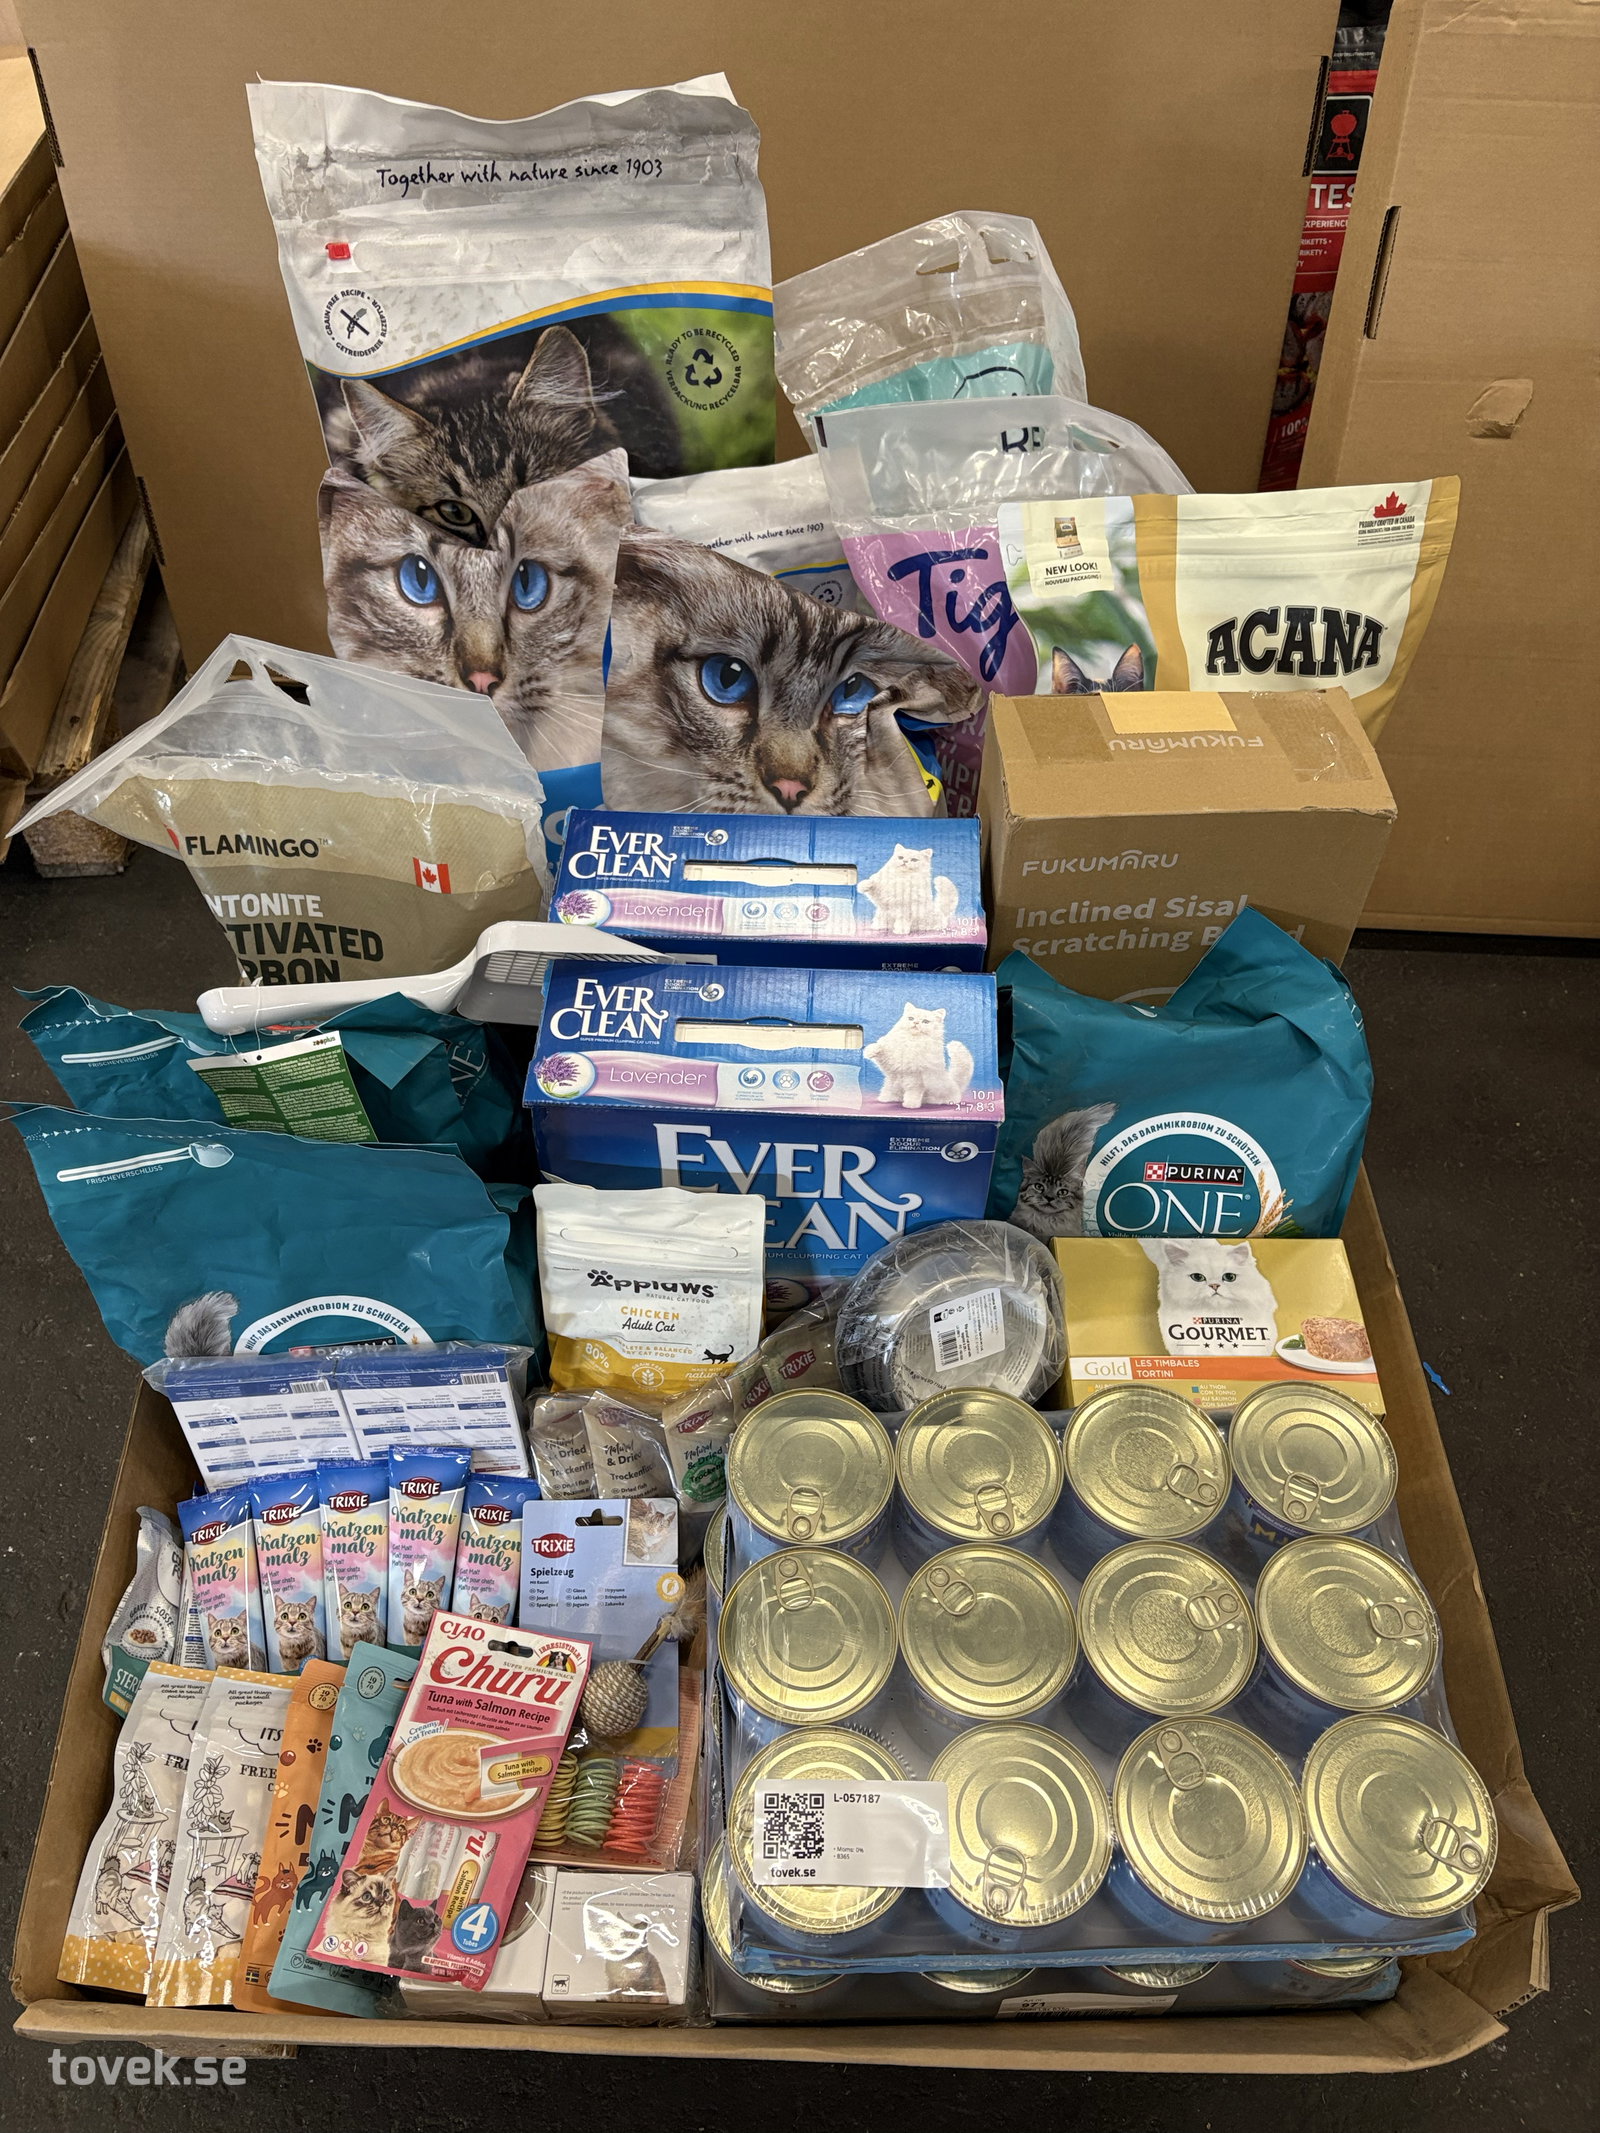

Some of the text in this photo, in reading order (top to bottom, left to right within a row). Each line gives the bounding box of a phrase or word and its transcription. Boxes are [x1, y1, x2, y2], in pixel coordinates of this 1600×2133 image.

[376, 159, 663, 198] Together with nature since 1903
[324, 289, 365, 336] GRAIN FREE RECIPE
[336, 299, 387, 357] GETREIDEFREIE REZEPTUR
[666, 328, 740, 365] READY TO BE RECYCLED
[666, 366, 741, 411] VERPACKUNG RECYCELBAR
[735, 522, 824, 545] with nature since 1903
[1045, 562, 1098, 576] NEW LOOK!
[1045, 574, 1099, 586] NOUVEAU PACKAGING
[1206, 605, 1383, 678] ACANA
[185, 835, 320, 858] FLAMINGO
[590, 826, 677, 861] EVER
[568, 851, 674, 879] CLEAN
[624, 902, 714, 918] Lavender
[1015, 894, 1248, 929] Inclined Sisal
[1013, 927, 1192, 956] Scratching
[574, 978, 669, 1020] EVER
[550, 1008, 663, 1040] CLEAN
[312, 1036, 336, 1047] zooplus
[88, 1052, 159, 1068] FRISCHEVERSCHLUSS
[610, 1067, 707, 1086] Lavender
[976, 1102, 995, 1112] 8.3
[1100, 1120, 1262, 1167] HILFT, DAS DARMMIKROBIOM ZU SCHÜTZEN
[86, 1164, 163, 1185] FRISCHEVERSCHLUSS
[653, 1123, 923, 1214] EVER
[1167, 1166, 1239, 1181] PURINA
[1103, 1182, 1244, 1236] ONE
[587, 1268, 715, 1298] Applaws
[646, 1293, 675, 1301] NATURAL
[620, 1306, 680, 1320] CHICKEN
[1203, 1317, 1240, 1325] PURINA
[245, 1302, 411, 1351] HILFT, DAS DARMMIKROBIOM ZU SCHÜTZEN
[621, 1317, 676, 1333] Adult Cat
[1168, 1323, 1269, 1342] GOURMET
[585, 1342, 610, 1369] 80%
[653, 1346, 693, 1355] BALANCED
[1083, 1361, 1128, 1378] Gold
[1135, 1358, 1200, 1368] LES TIMBALES
[1136, 1369, 1174, 1378] TORTINI
[559, 1445, 586, 1459] Dried
[619, 1451, 642, 1465] Dried
[392, 1506, 457, 1526] Katzen-
[322, 1521, 388, 1540] Katzen-
[400, 1525, 447, 1545] malz
[257, 1531, 321, 1552] Katzen-
[331, 1539, 377, 1557] malz
[189, 1547, 248, 1572] Katzen-
[266, 1549, 311, 1567] malz
[468, 1552, 514, 1571] malz
[197, 1564, 240, 1586] malz
[530, 1567, 575, 1578] Spielzeug
[130, 1602, 174, 1627] GRAVY SOSSE
[440, 1620, 485, 1641] CIAO
[539, 1642, 582, 1662] IRRESISTIBLE!
[429, 1646, 572, 1706] Churu
[503, 1661, 575, 1680] SUPER PREMIUM SNACK
[428, 1690, 551, 1724] Tuna with Salmon Recipe
[260, 1727, 284, 1741] ITS
[407, 1726, 443, 1743] Cat Treat!
[409, 1720, 439, 1735] Creamy
[240, 1764, 277, 1779] FREE
[498, 1766, 543, 1779] Salmon Recipe
[504, 1760, 535, 1771] Tuna with
[833, 1793, 881, 1804] L-057187
[771, 1867, 816, 1878] tovek.se
[447, 1870, 469, 1919] Salmon Recipe
[462, 1879, 473, 1895] Tuna
[461, 1905, 490, 1942] 4
[463, 1939, 478, 1948] Tubes
[447, 1953, 465, 1963] Vitamin
